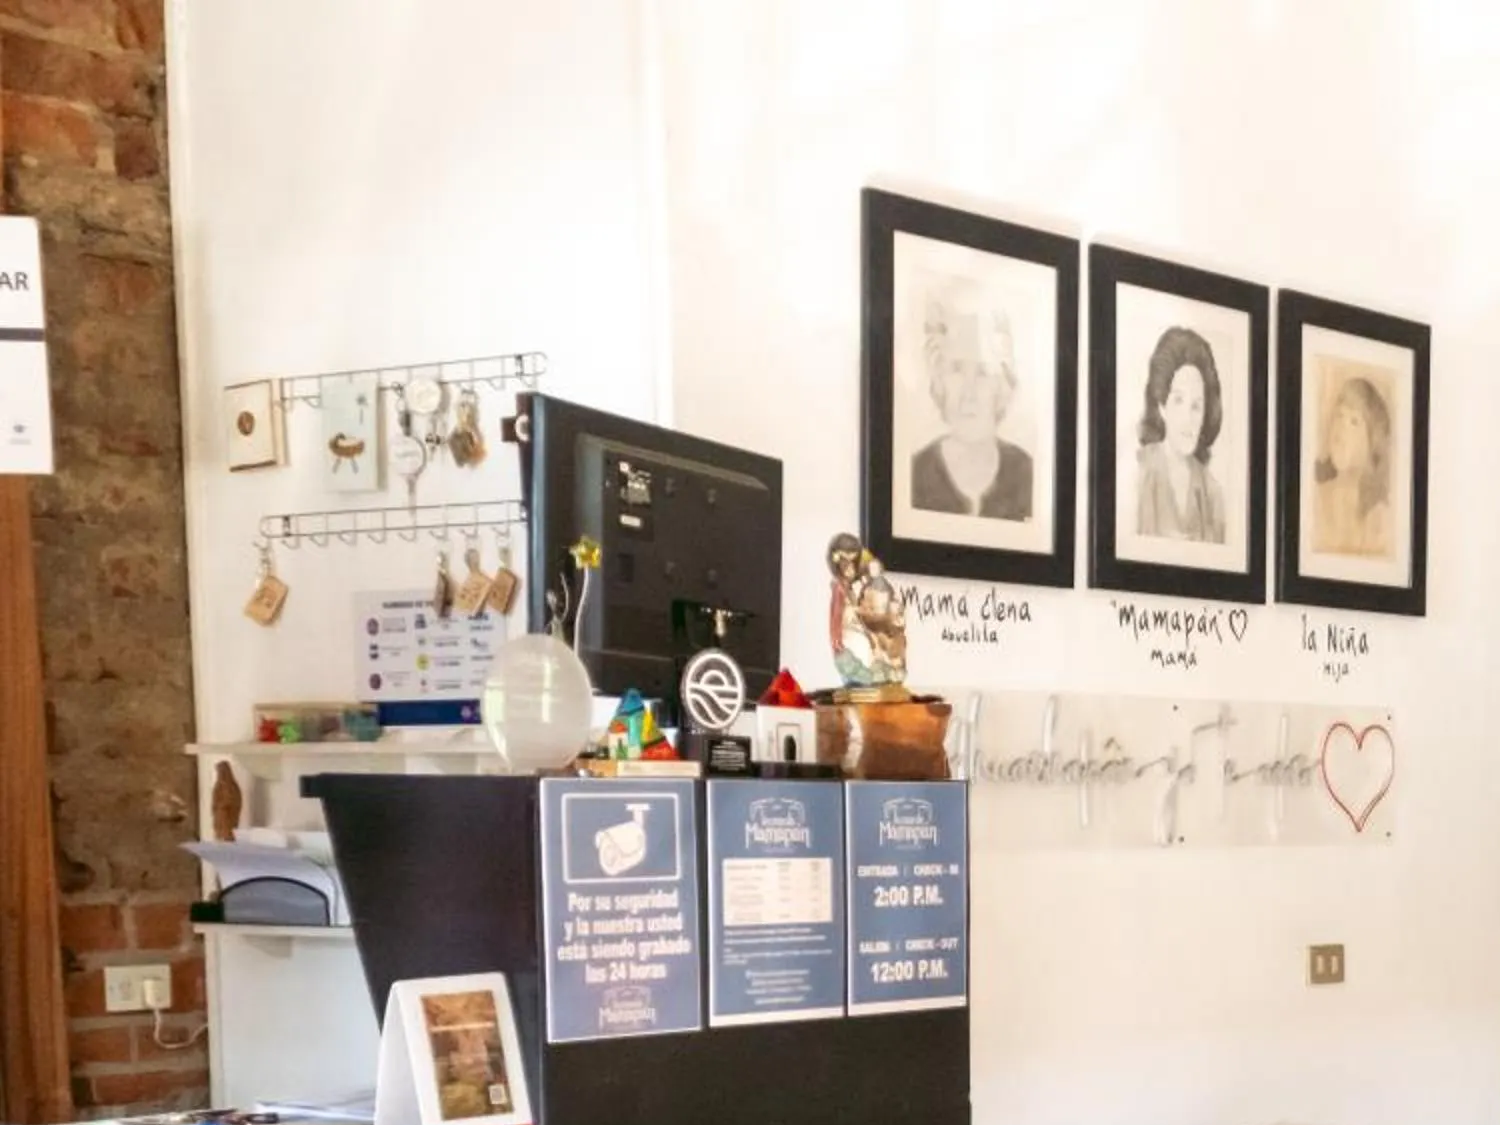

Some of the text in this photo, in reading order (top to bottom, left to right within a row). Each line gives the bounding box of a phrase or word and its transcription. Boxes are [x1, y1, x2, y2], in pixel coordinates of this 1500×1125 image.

[1326, 623, 1370, 657] Niña
[568, 888, 679, 914] Por su seguridad
[873, 884, 944, 908] 2:00 P.M.
[563, 911, 683, 942] y la nuestra usted
[591, 937, 636, 959] siendo
[638, 935, 691, 961] grabado
[585, 961, 667, 983] las 24 horas
[871, 958, 949, 984] 12:00 P.M.
